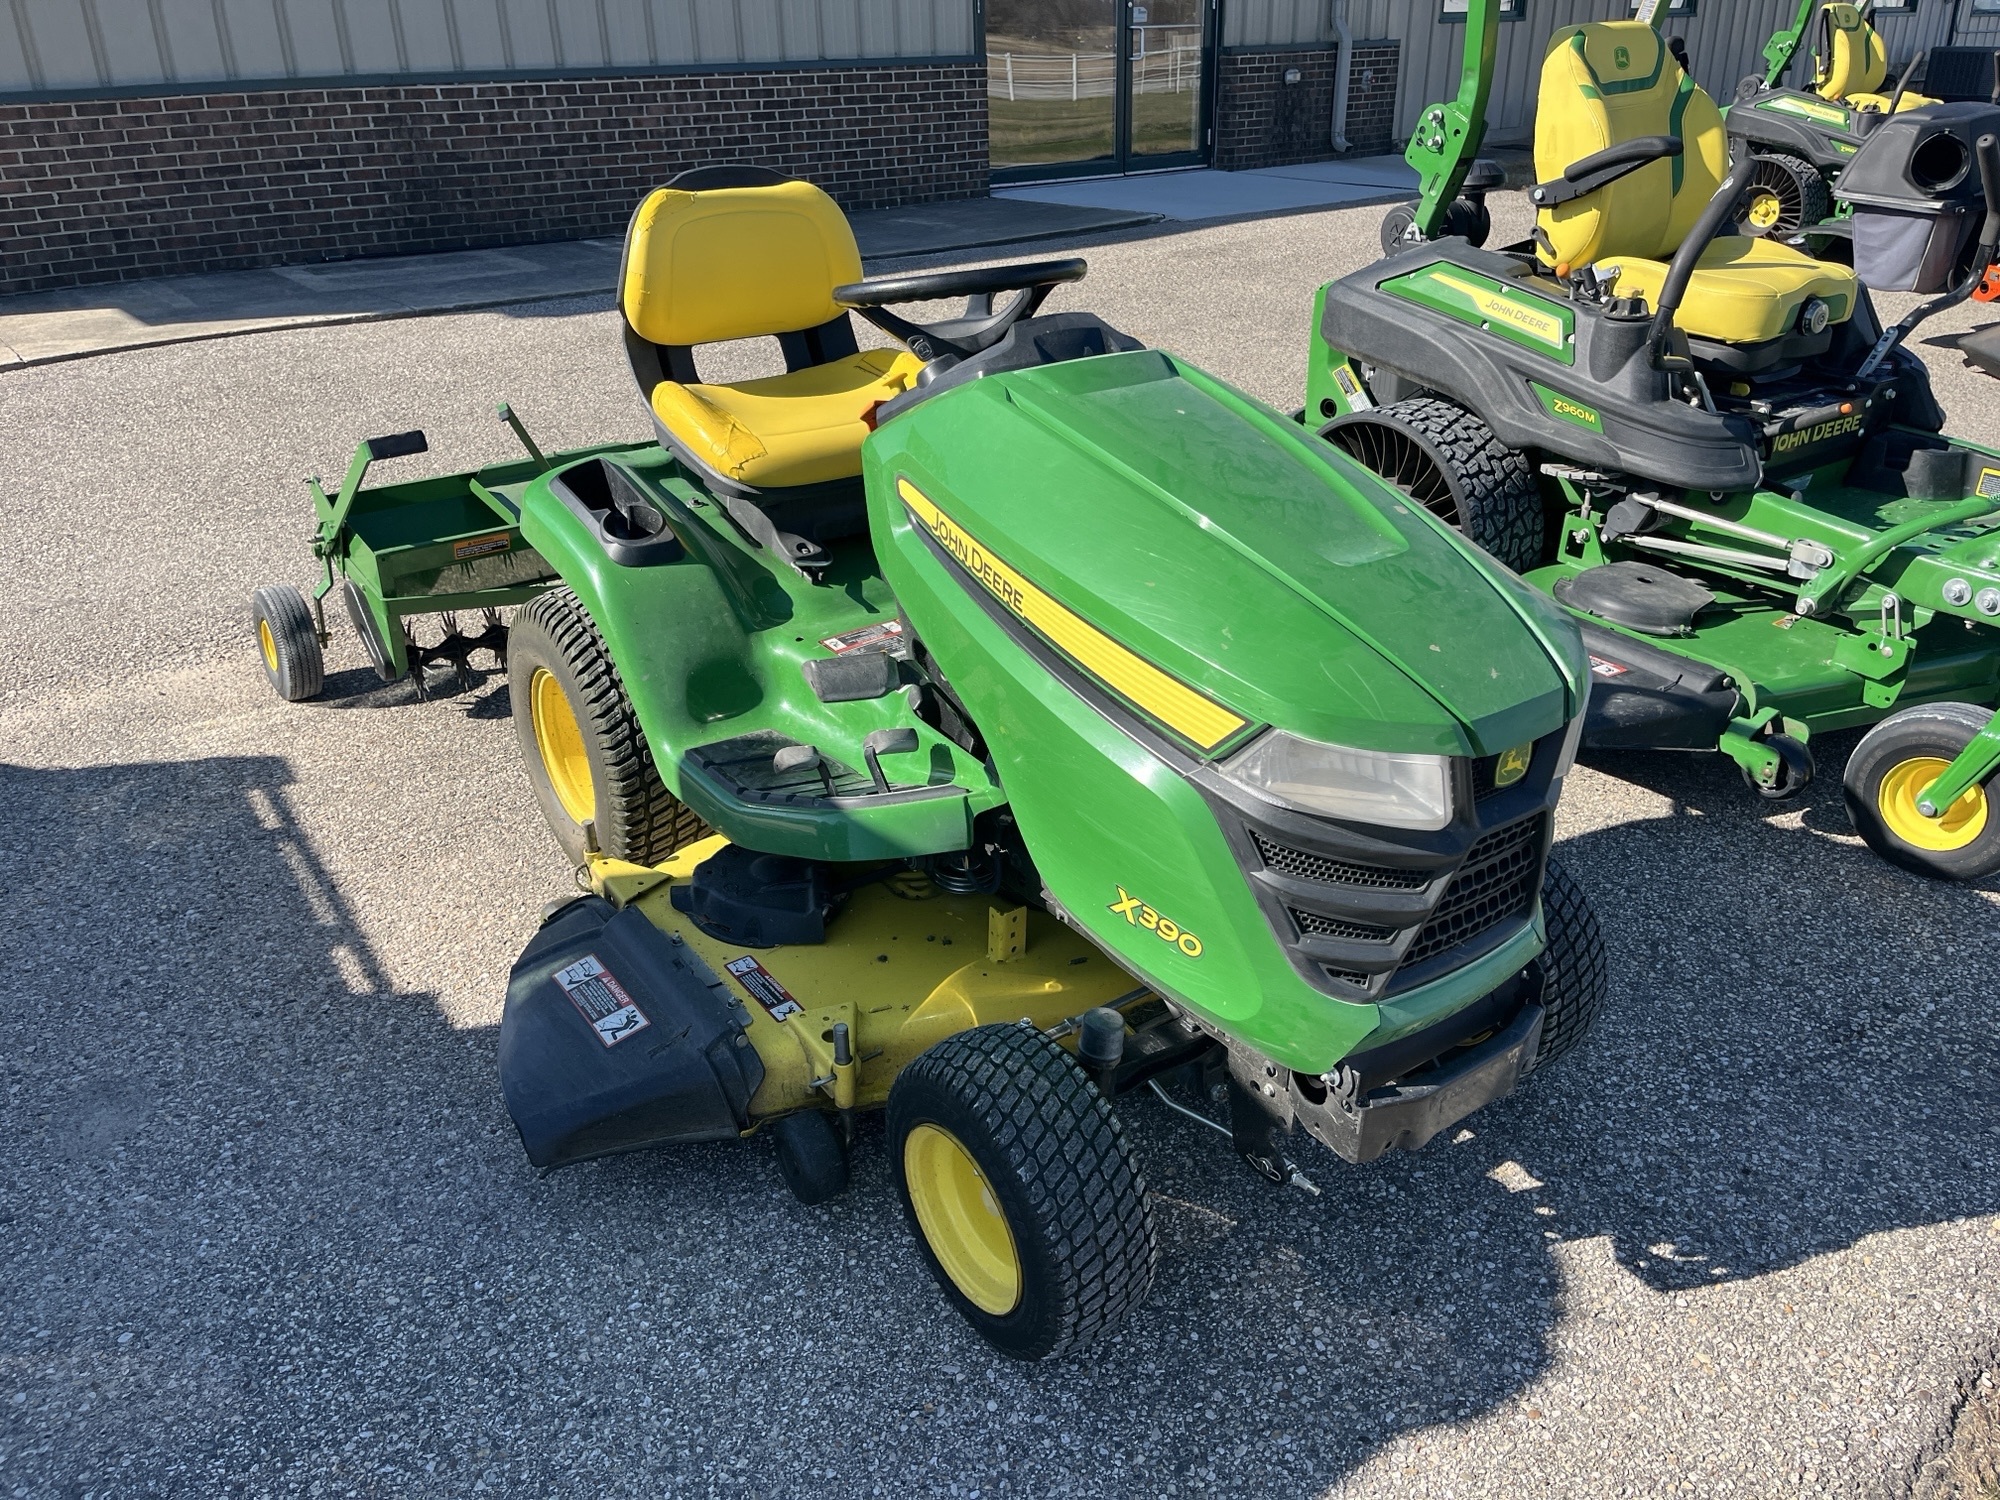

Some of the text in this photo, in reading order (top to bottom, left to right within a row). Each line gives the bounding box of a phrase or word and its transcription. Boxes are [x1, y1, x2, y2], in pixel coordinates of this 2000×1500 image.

[1485, 299, 1550, 332] JOHN DEERE
[1553, 398, 1595, 424] Z960M
[1773, 414, 1863, 452] JOHN DEERE
[931, 511, 1024, 613] JOHN DEERE
[1106, 884, 1204, 958] X390
[606, 980, 630, 1004] DANGER
